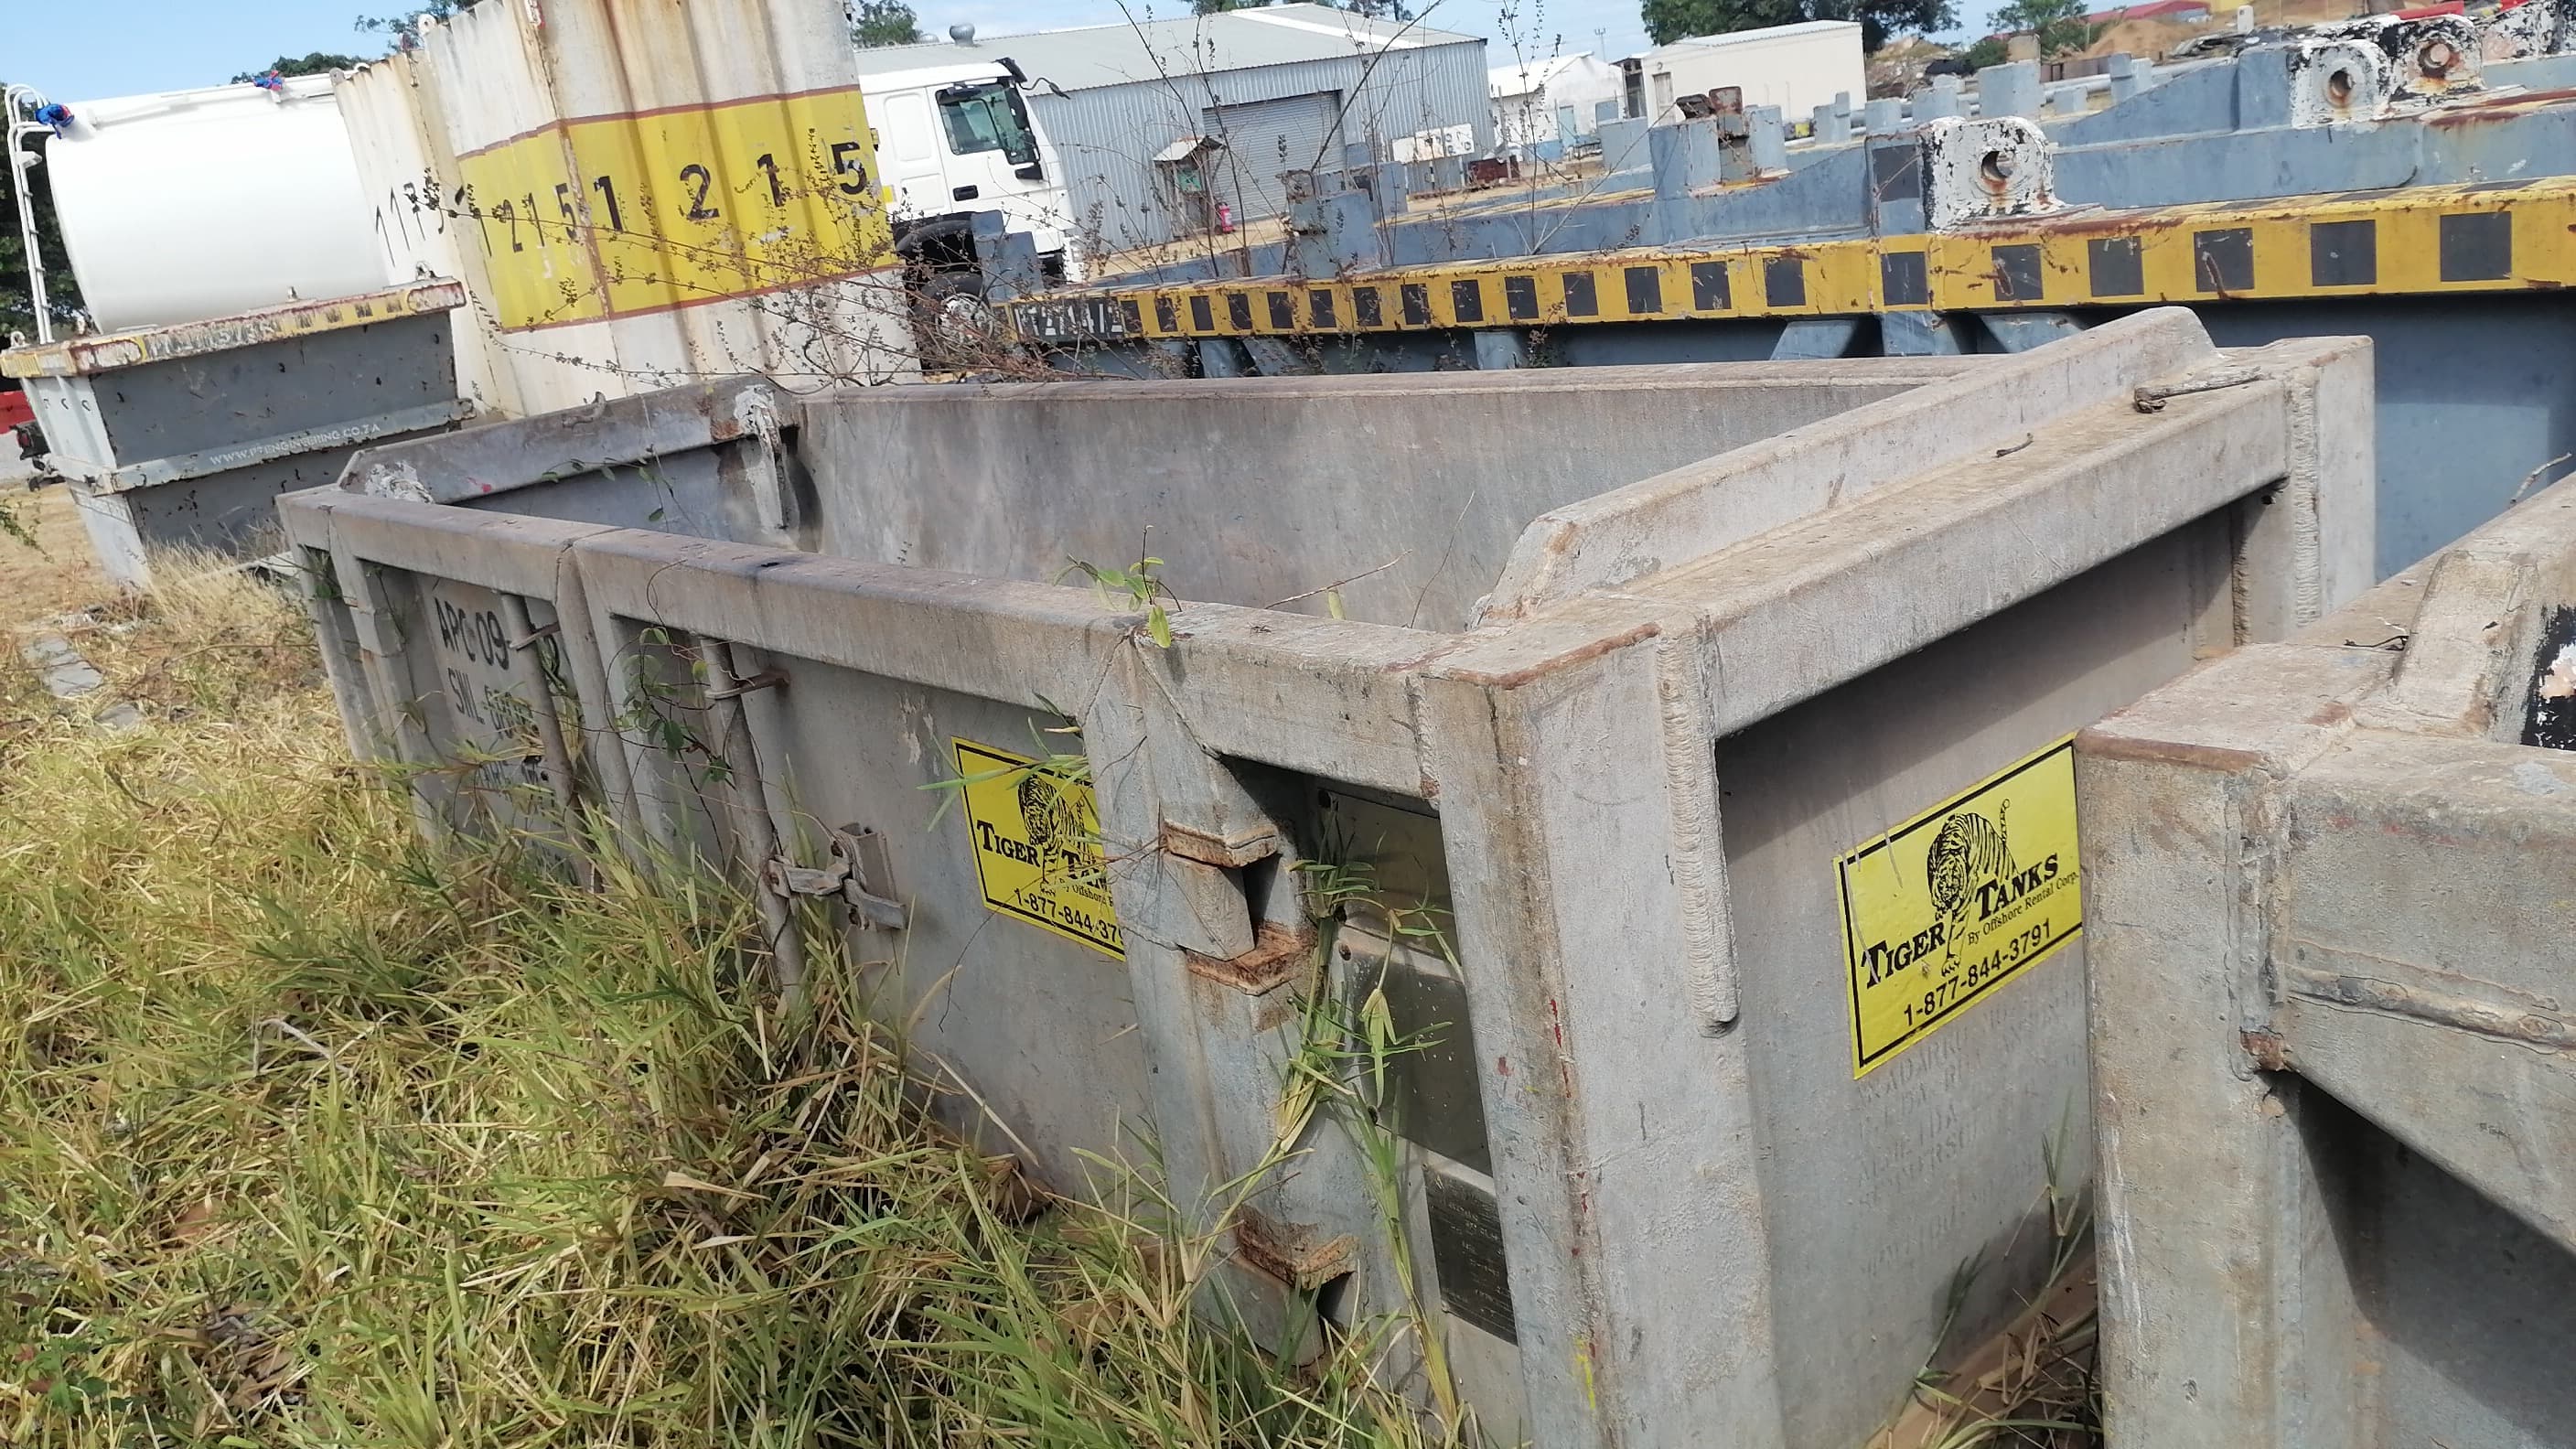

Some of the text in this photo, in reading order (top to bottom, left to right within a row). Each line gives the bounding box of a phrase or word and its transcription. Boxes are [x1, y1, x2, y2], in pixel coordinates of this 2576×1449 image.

[593, 141, 869, 231] 1215
[976, 819, 1041, 868] TIGER
[1861, 852, 2058, 990] TIGER TANKS
[1982, 904, 2023, 936] Offshore
[2023, 882, 2055, 910] Rental
[1903, 918, 2051, 1026] 1-877-844-3791
